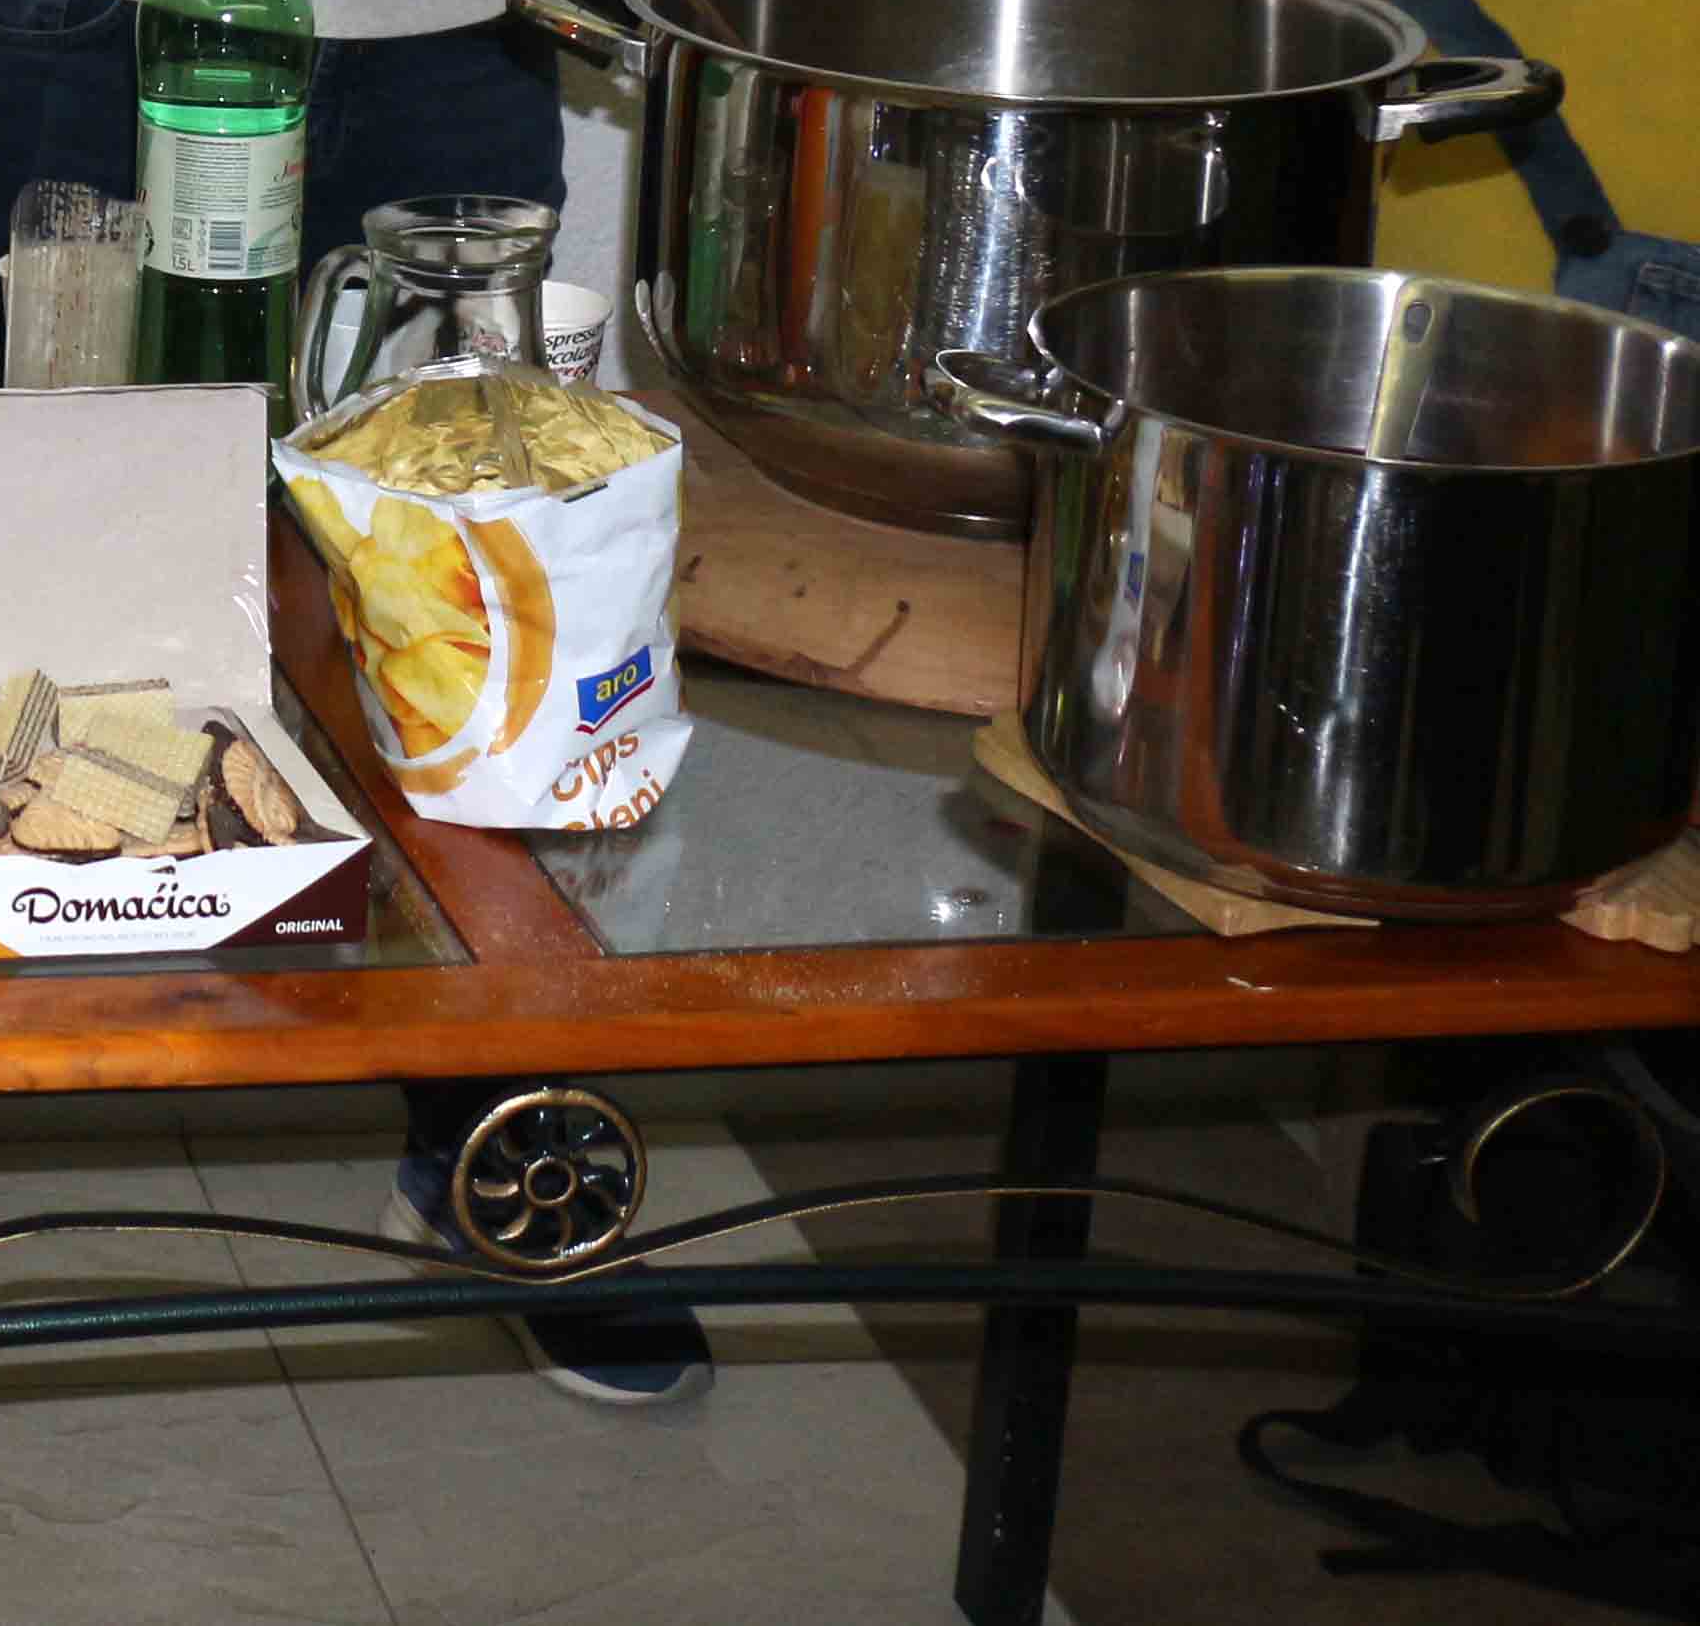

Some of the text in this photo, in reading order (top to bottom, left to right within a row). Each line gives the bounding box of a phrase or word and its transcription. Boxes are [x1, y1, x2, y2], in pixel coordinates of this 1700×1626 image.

[595, 663, 638, 702] aro
[564, 768, 665, 830] lani
[12, 882, 231, 924] Domaćica
[274, 917, 344, 935] ORIGINAL
